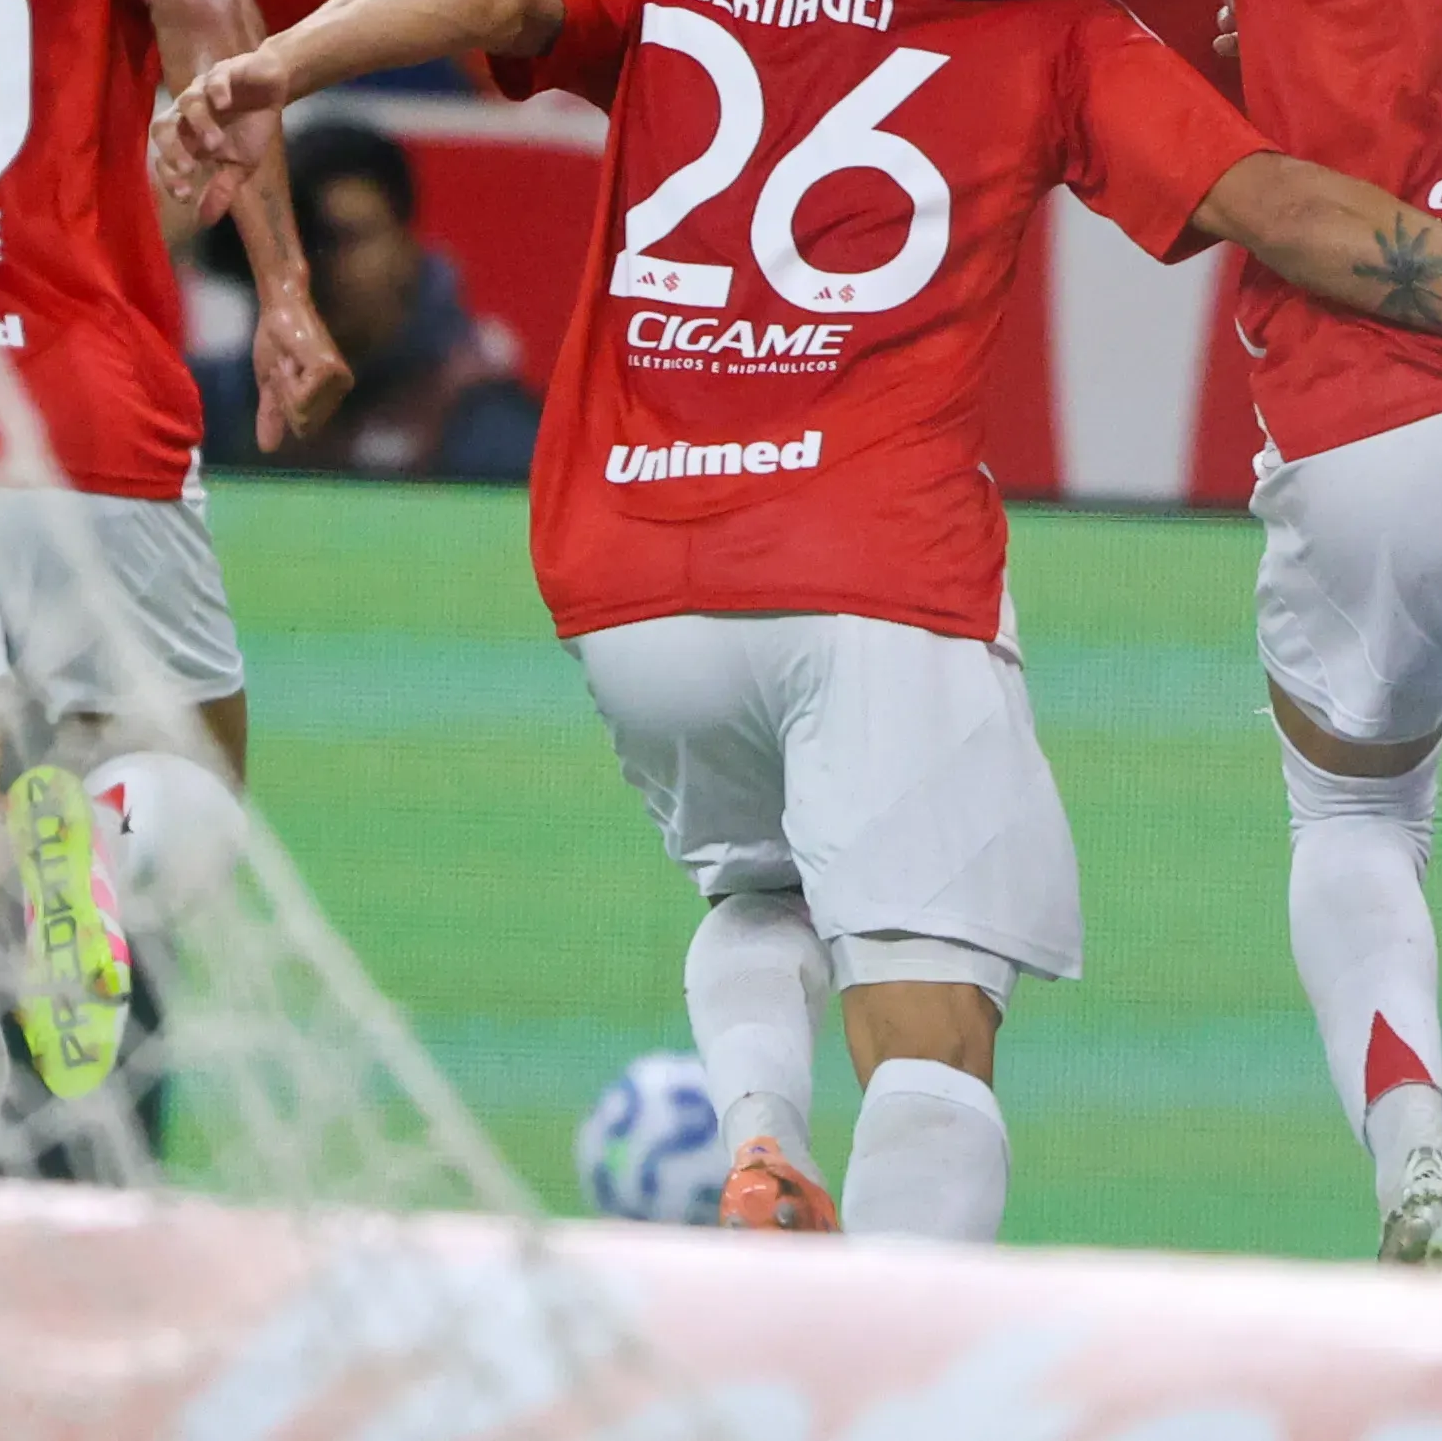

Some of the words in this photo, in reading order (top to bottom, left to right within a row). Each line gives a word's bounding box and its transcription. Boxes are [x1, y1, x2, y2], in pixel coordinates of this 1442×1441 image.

[610, 3, 951, 313] 26
[627, 311, 853, 358] CIGAME
[711, 361, 720, 374] E
[605, 430, 823, 484] Unimed
